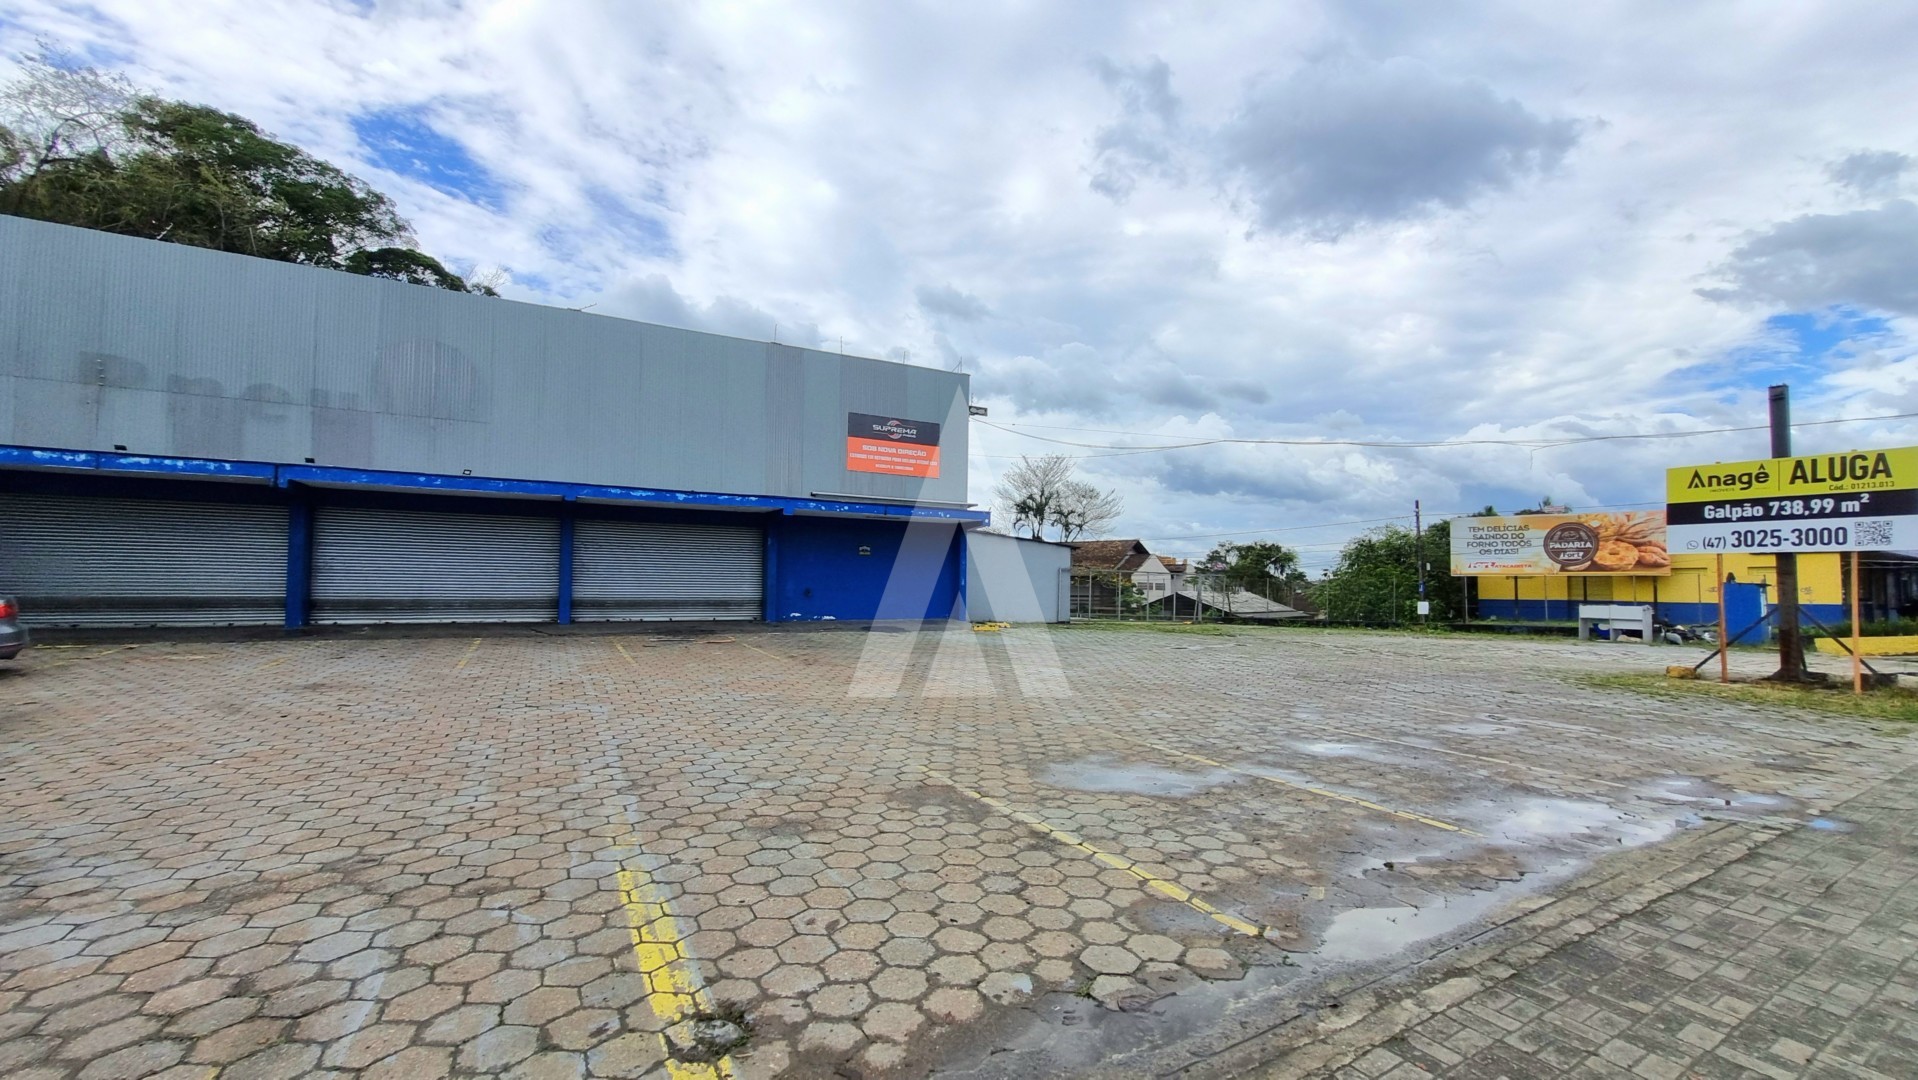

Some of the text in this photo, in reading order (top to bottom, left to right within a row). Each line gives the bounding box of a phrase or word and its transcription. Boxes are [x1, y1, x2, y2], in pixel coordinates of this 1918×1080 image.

[872, 424, 917, 435] SUPREMA
[878, 446, 897, 454] NOVA
[898, 447, 927, 457] DIREÇÃO
[1687, 462, 1770, 491] Anagê
[1789, 452, 1893, 485] ALUGA
[1703, 493, 1870, 522] Galpão 738,99 m²
[1486, 523, 1530, 532] DELÍCIAS
[1549, 541, 1593, 549] PADARIA
[1702, 526, 1848, 550] (47) 3025-3000
